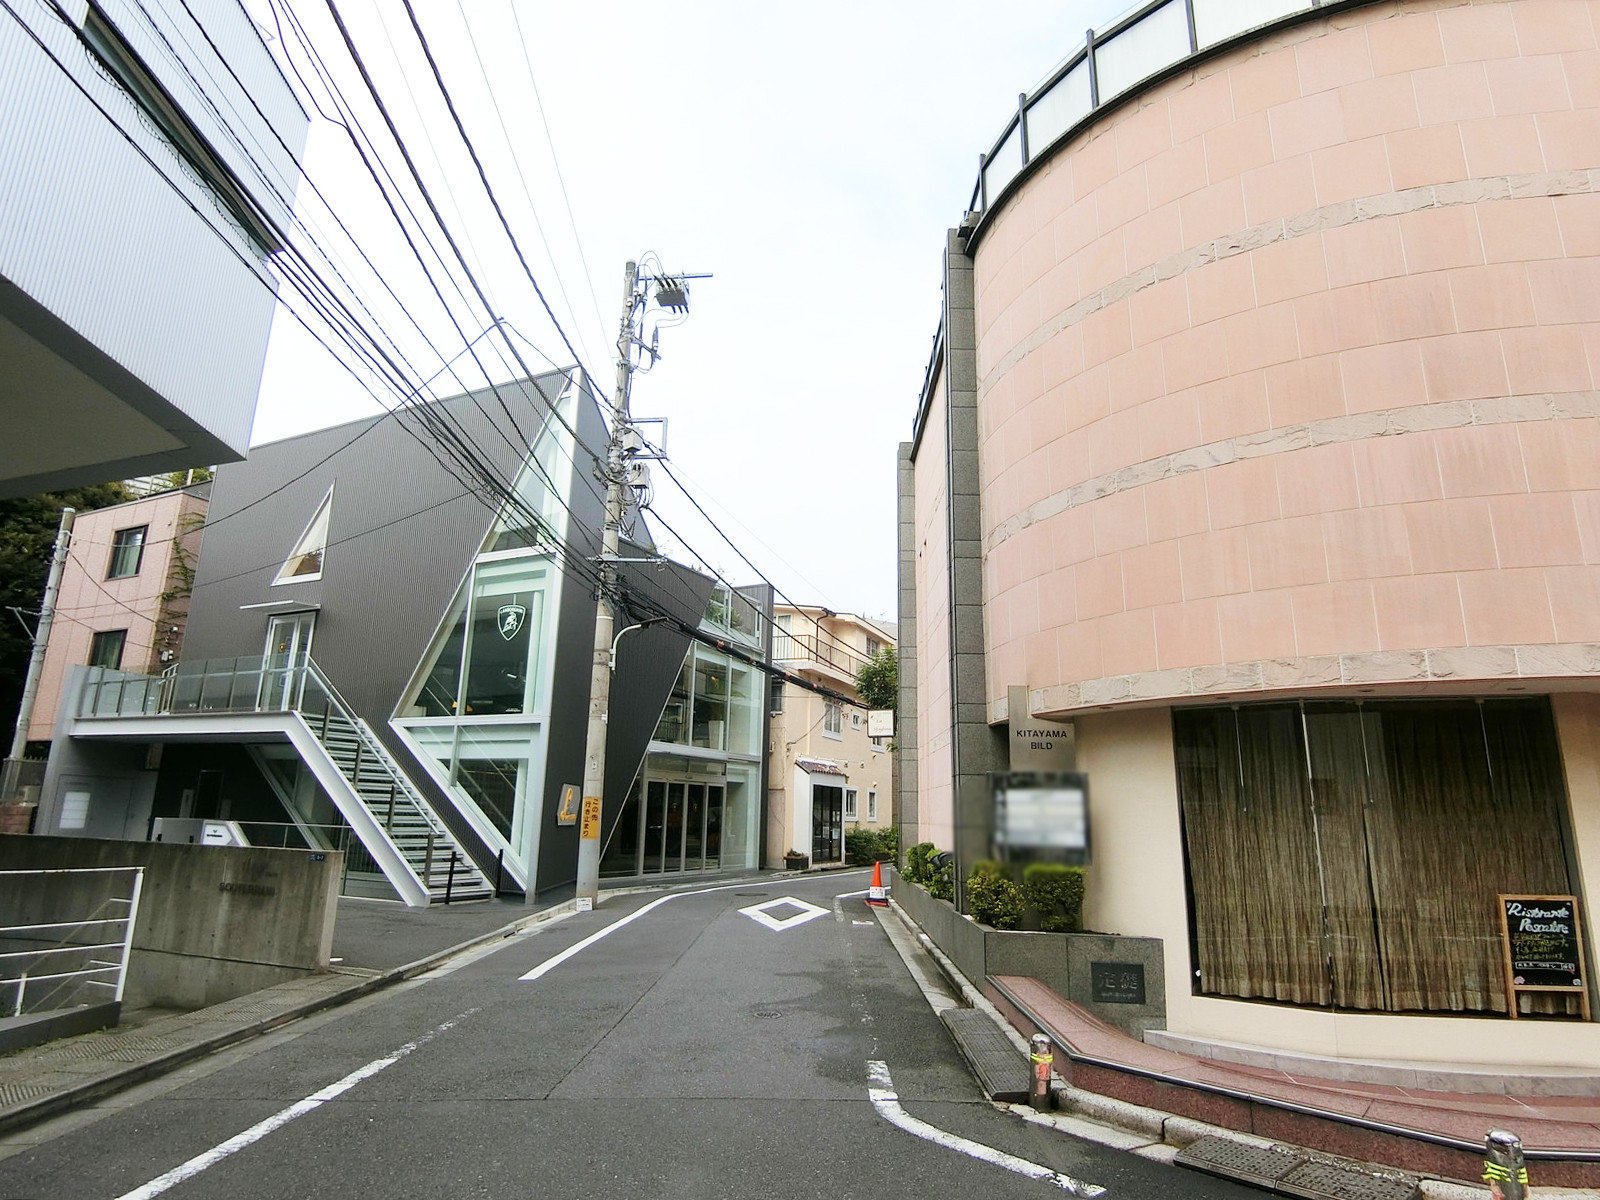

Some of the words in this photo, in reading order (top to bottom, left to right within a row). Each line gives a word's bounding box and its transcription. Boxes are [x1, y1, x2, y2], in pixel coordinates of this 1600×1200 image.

[1016, 730, 1068, 738] KITAYAMA
[1031, 742, 1053, 750] BILD
[591, 798, 599, 821] この先
[582, 801, 592, 837] 行き止まり
